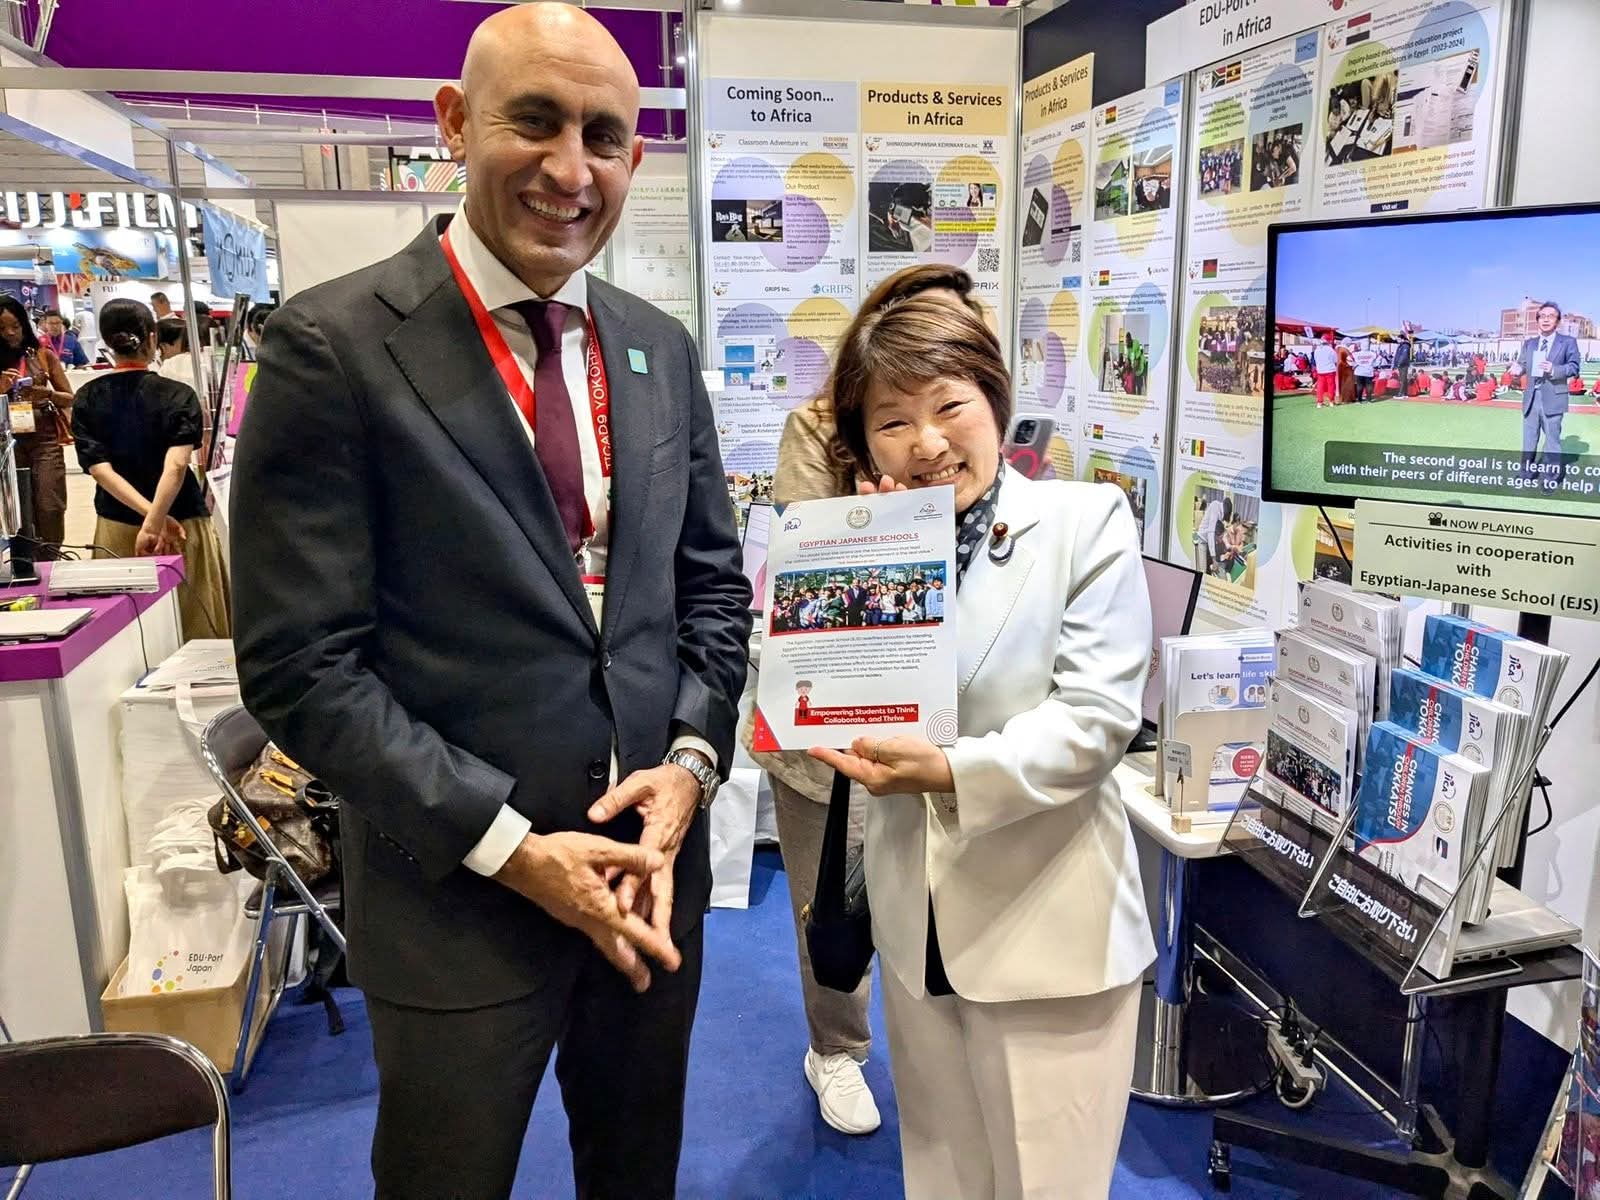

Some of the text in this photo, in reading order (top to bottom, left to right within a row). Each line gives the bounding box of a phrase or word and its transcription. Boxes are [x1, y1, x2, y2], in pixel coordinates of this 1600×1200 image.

[1223, 16, 1272, 47] in Africa
[1442, 27, 1463, 41] project
[1024, 66, 1088, 103] Products & Services
[727, 86, 834, 104] Coming Soon...
[868, 89, 1002, 106] Products & Services
[751, 108, 812, 123] to Africa
[1040, 96, 1067, 118] in Africa
[907, 112, 963, 126] in Africa
[0, 191, 197, 228] UJIFILM
[821, 284, 852, 294] GRIPS
[1383, 451, 1406, 465] The
[1409, 453, 1455, 468] second
[1459, 456, 1487, 473] goal
[1492, 457, 1502, 471] is
[1507, 459, 1521, 472] to
[1525, 460, 1561, 474] learn
[1565, 461, 1580, 475] to
[1331, 463, 1593, 494] with their peers of different ages to help
[1450, 519, 1534, 536] NOW PLAYING
[799, 532, 919, 549] EGYPTIAN JAPANESE SCHOOLS
[1384, 534, 1575, 566] Activities in cooperation
[1457, 563, 1491, 577] with
[1360, 571, 1599, 615] Egyptian-Japanese School (EJS)
[1191, 672, 1214, 680] Let's
[1217, 671, 1240, 680] learn
[810, 706, 917, 717] Empowering Students to Think,
[823, 716, 868, 724] Collaborate,
[883, 714, 905, 722] Thrive
[1387, 754, 1406, 827] TOKKATSU
[1400, 759, 1418, 833] CHANGES IN
[1240, 814, 1315, 868] ご自由にお取り下さい
[1328, 873, 1418, 943] ご自由にお取り下さい
[186, 964, 213, 974] Japan
